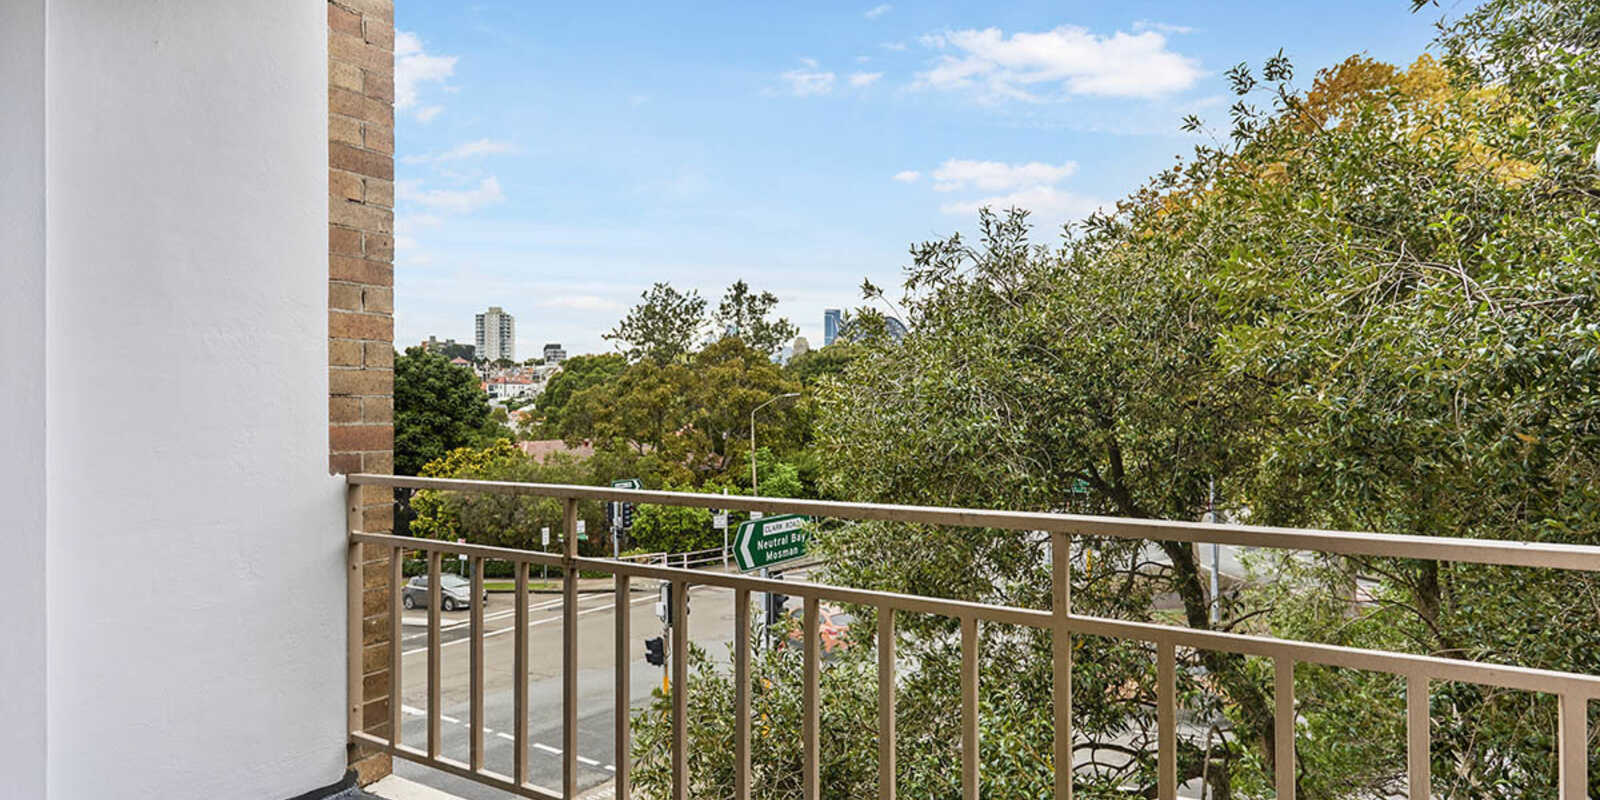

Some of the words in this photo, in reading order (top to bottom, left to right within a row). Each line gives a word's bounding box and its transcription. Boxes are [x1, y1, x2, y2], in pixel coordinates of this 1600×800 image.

[765, 523, 783, 533] CLARK
[757, 535, 789, 551] Neutral
[791, 533, 806, 543] Bay
[766, 547, 799, 561] Mosman
